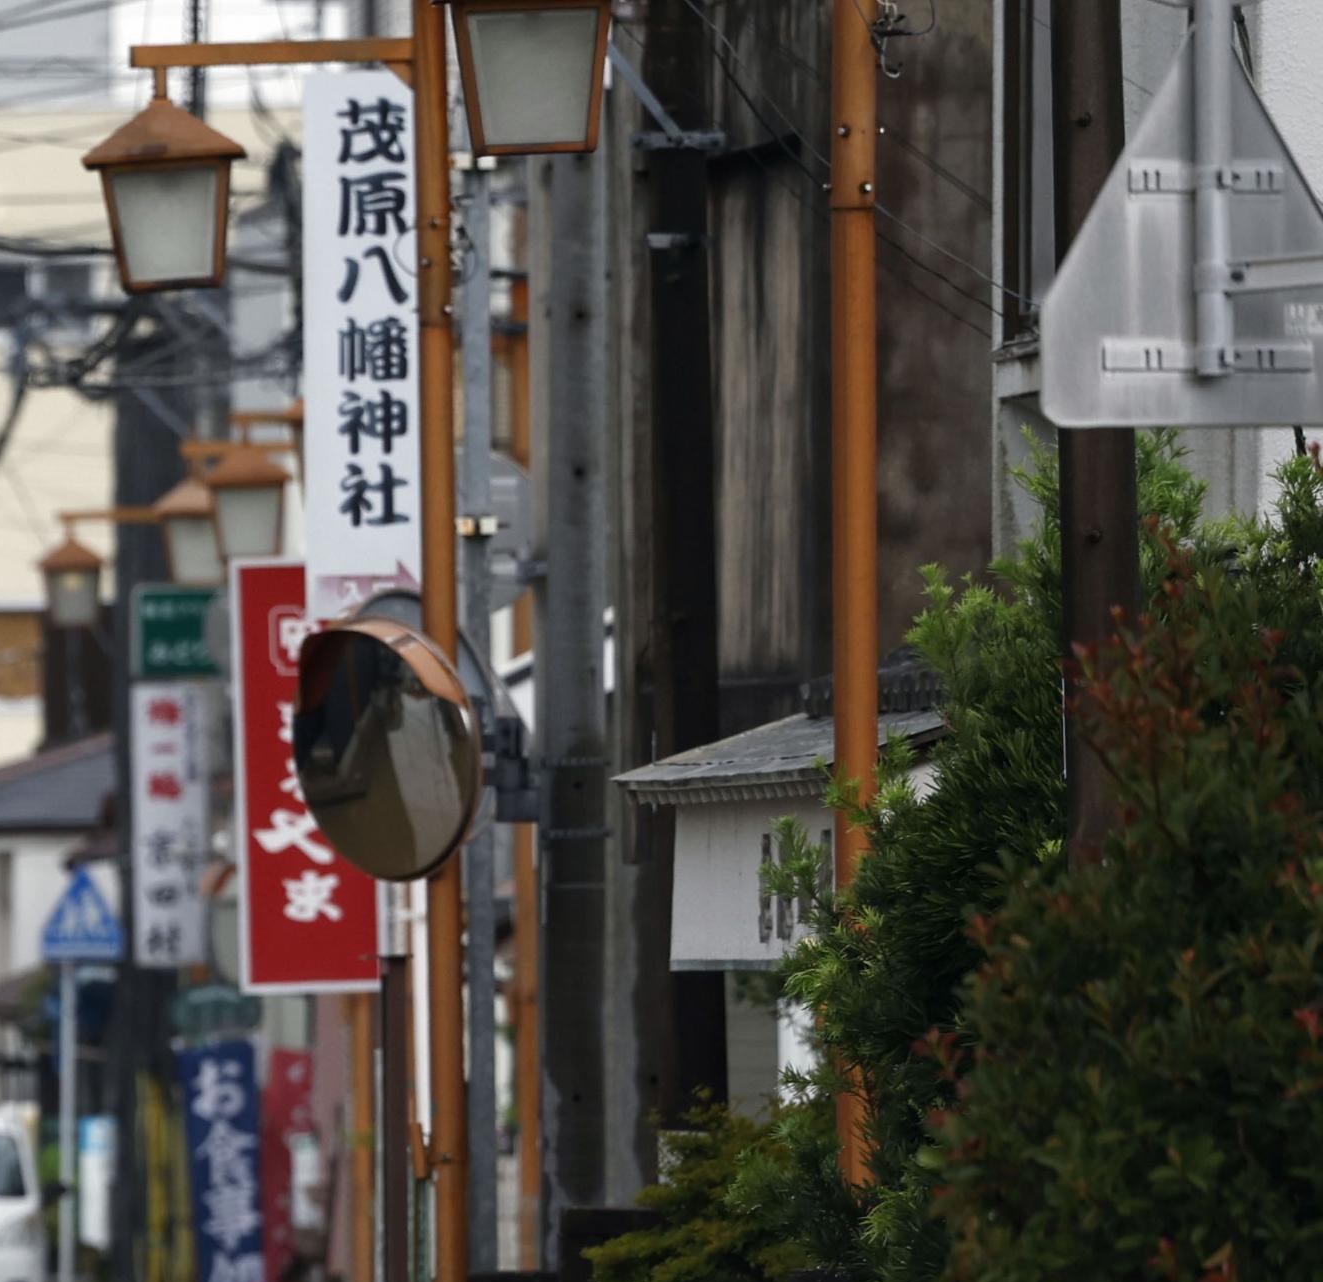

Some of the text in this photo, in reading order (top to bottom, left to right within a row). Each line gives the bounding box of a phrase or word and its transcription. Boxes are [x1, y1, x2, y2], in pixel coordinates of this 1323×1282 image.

[335, 96, 412, 528] 茂原八幡神社
